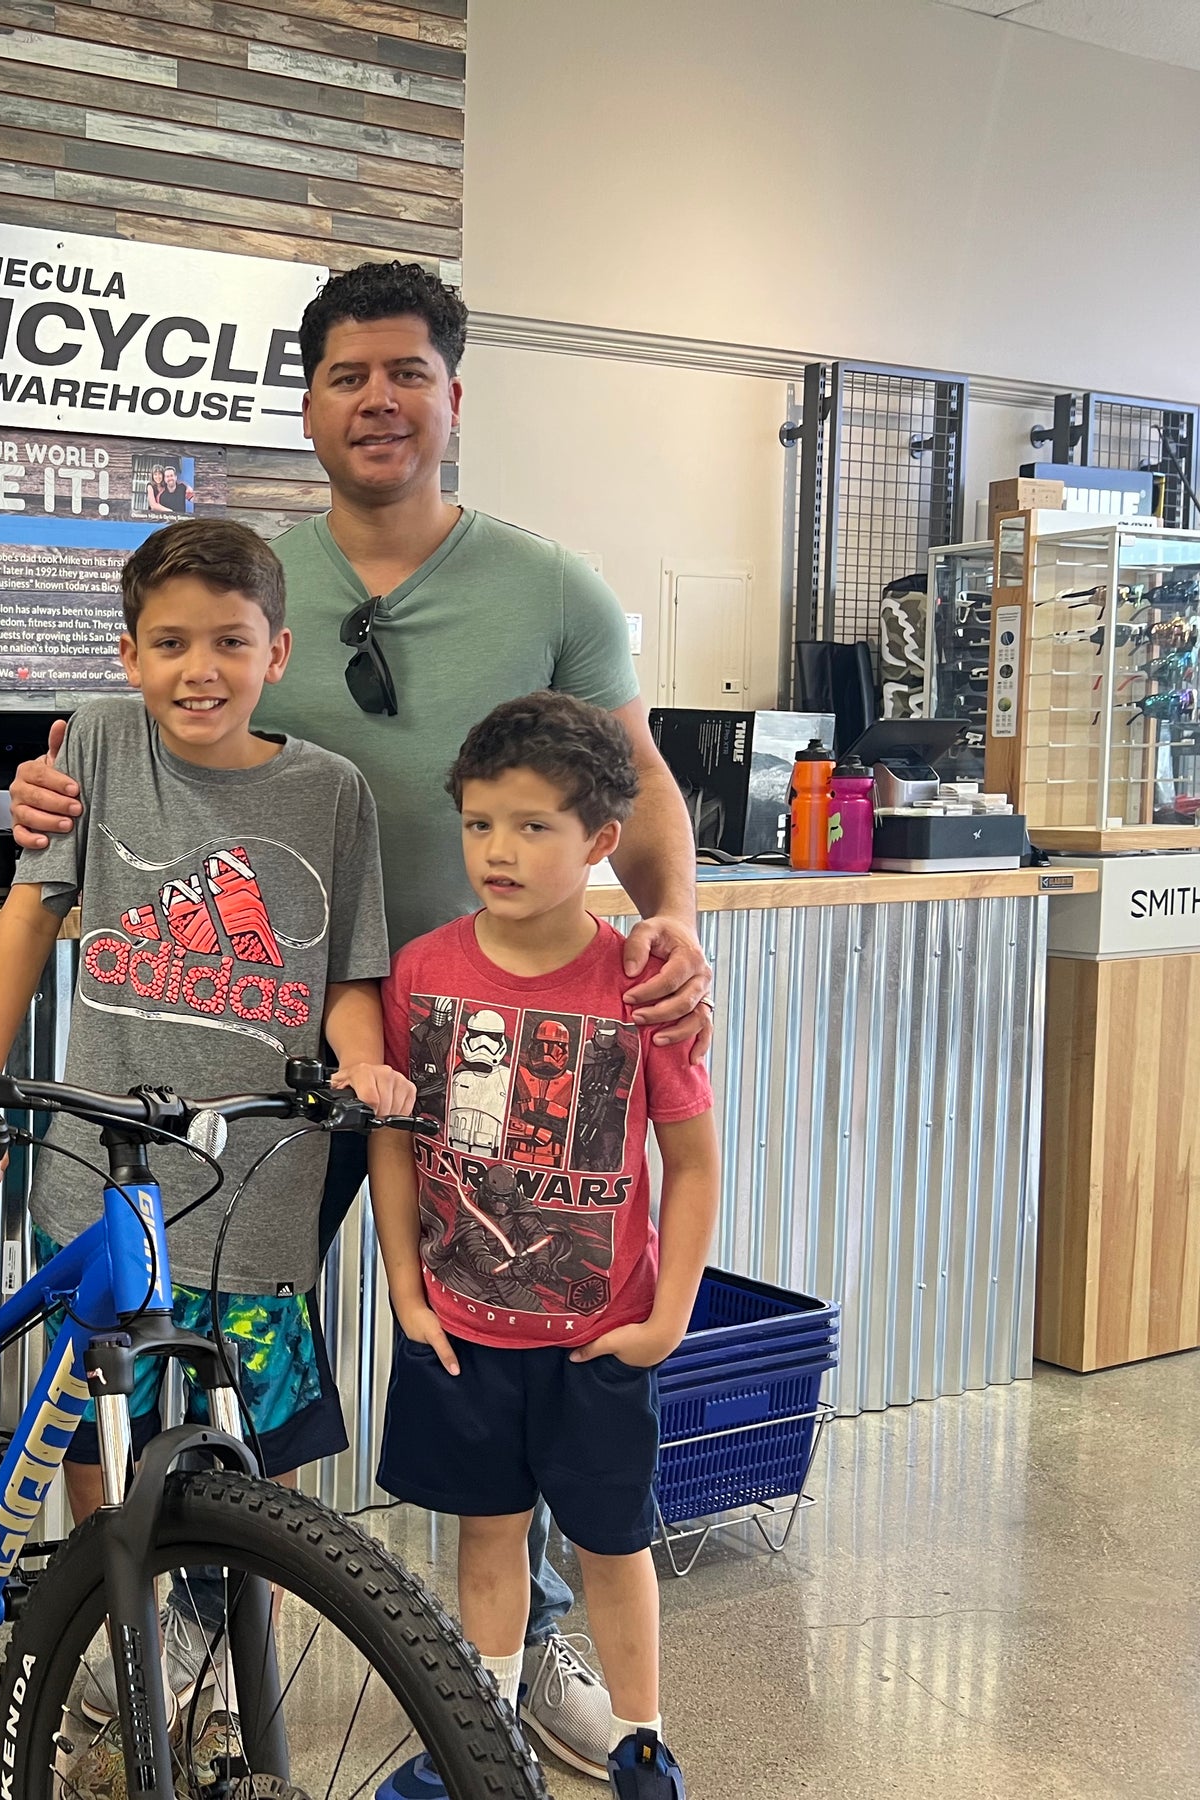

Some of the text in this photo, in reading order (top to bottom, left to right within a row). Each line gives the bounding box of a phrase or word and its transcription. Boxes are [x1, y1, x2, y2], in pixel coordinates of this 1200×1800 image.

[24, 443, 110, 469] WORLD
[43, 467, 110, 517] IT!
[20, 554, 36, 562] dad
[38, 554, 58, 564] took
[59, 555, 80, 565] Mike
[94, 557, 106, 566] his
[107, 557, 124, 567] first
[3, 565, 24, 575] later
[25, 567, 34, 575] in
[35, 567, 57, 577] 1992
[59, 568, 77, 579] they
[79, 571, 99, 579] gave
[100, 572, 110, 580] up
[112, 571, 123, 579] th
[35, 580, 65, 590] known
[66, 581, 90, 593] today
[101, 582, 122, 594] Bicy
[15, 605, 30, 614] has
[31, 605, 61, 617] always
[62, 606, 83, 616] been
[85, 608, 93, 616] to
[94, 607, 123, 618] inspire
[28, 618, 56, 628] fitness
[58, 620, 73, 628] and
[75, 620, 91, 629] fun.
[92, 620, 112, 630] They
[22, 631, 35, 639] for
[36, 632, 70, 642] growing
[72, 632, 88, 641] this
[89, 633, 104, 641] San
[106, 633, 121, 642] Die
[9, 643, 43, 653] nation's
[44, 645, 59, 655] top
[60, 644, 90, 655] bicycle
[91, 645, 120, 654] retaile
[31, 671, 45, 679] our
[48, 669, 70, 679] Team
[72, 670, 87, 679] and
[732, 721, 747, 763] THULE
[84, 937, 310, 1027] adidas
[514, 1168, 633, 1207] WARS
[546, 1320, 575, 1330] IX
[0, 1653, 37, 1800] KENDA
